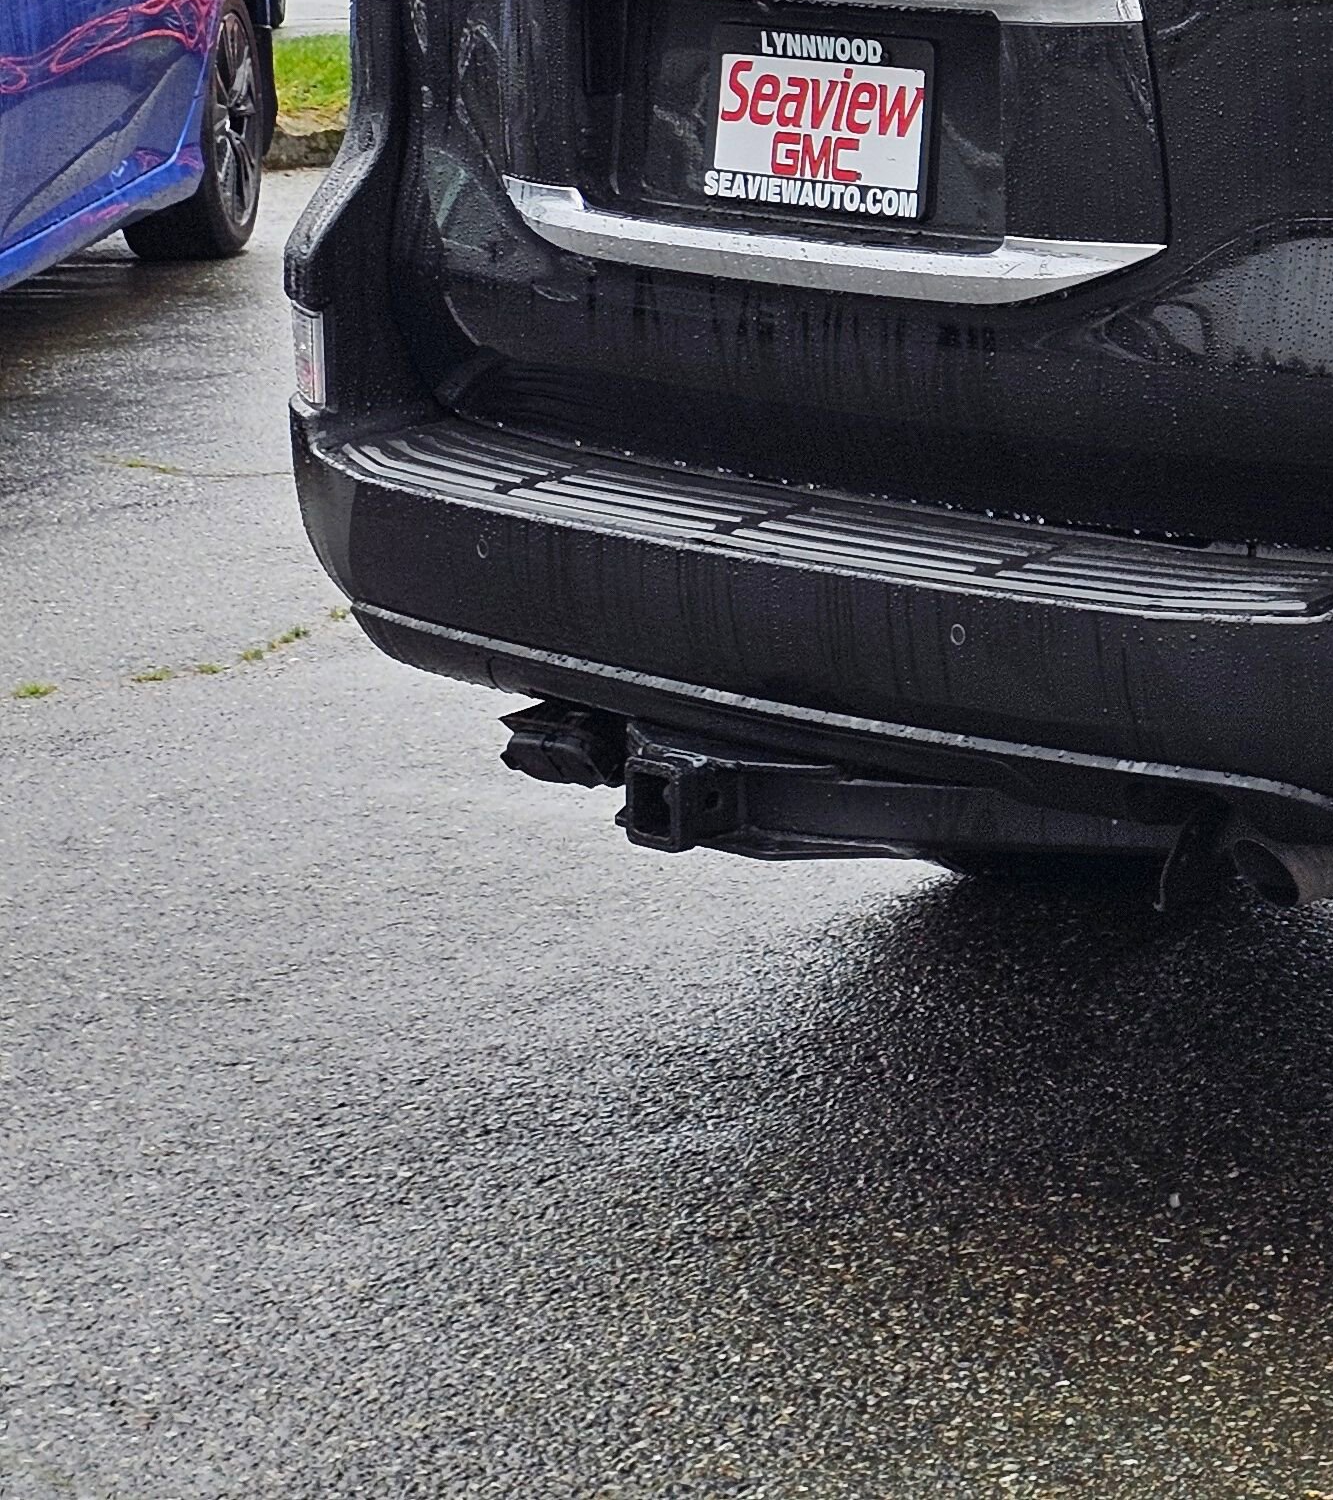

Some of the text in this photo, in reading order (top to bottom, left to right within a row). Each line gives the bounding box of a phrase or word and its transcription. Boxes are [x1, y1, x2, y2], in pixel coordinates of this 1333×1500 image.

[760, 30, 883, 64] LYNNWOOD
[720, 59, 925, 138] Seaview
[770, 131, 862, 182] GMC
[703, 170, 918, 218] SEAVIEWAUTO.COM
